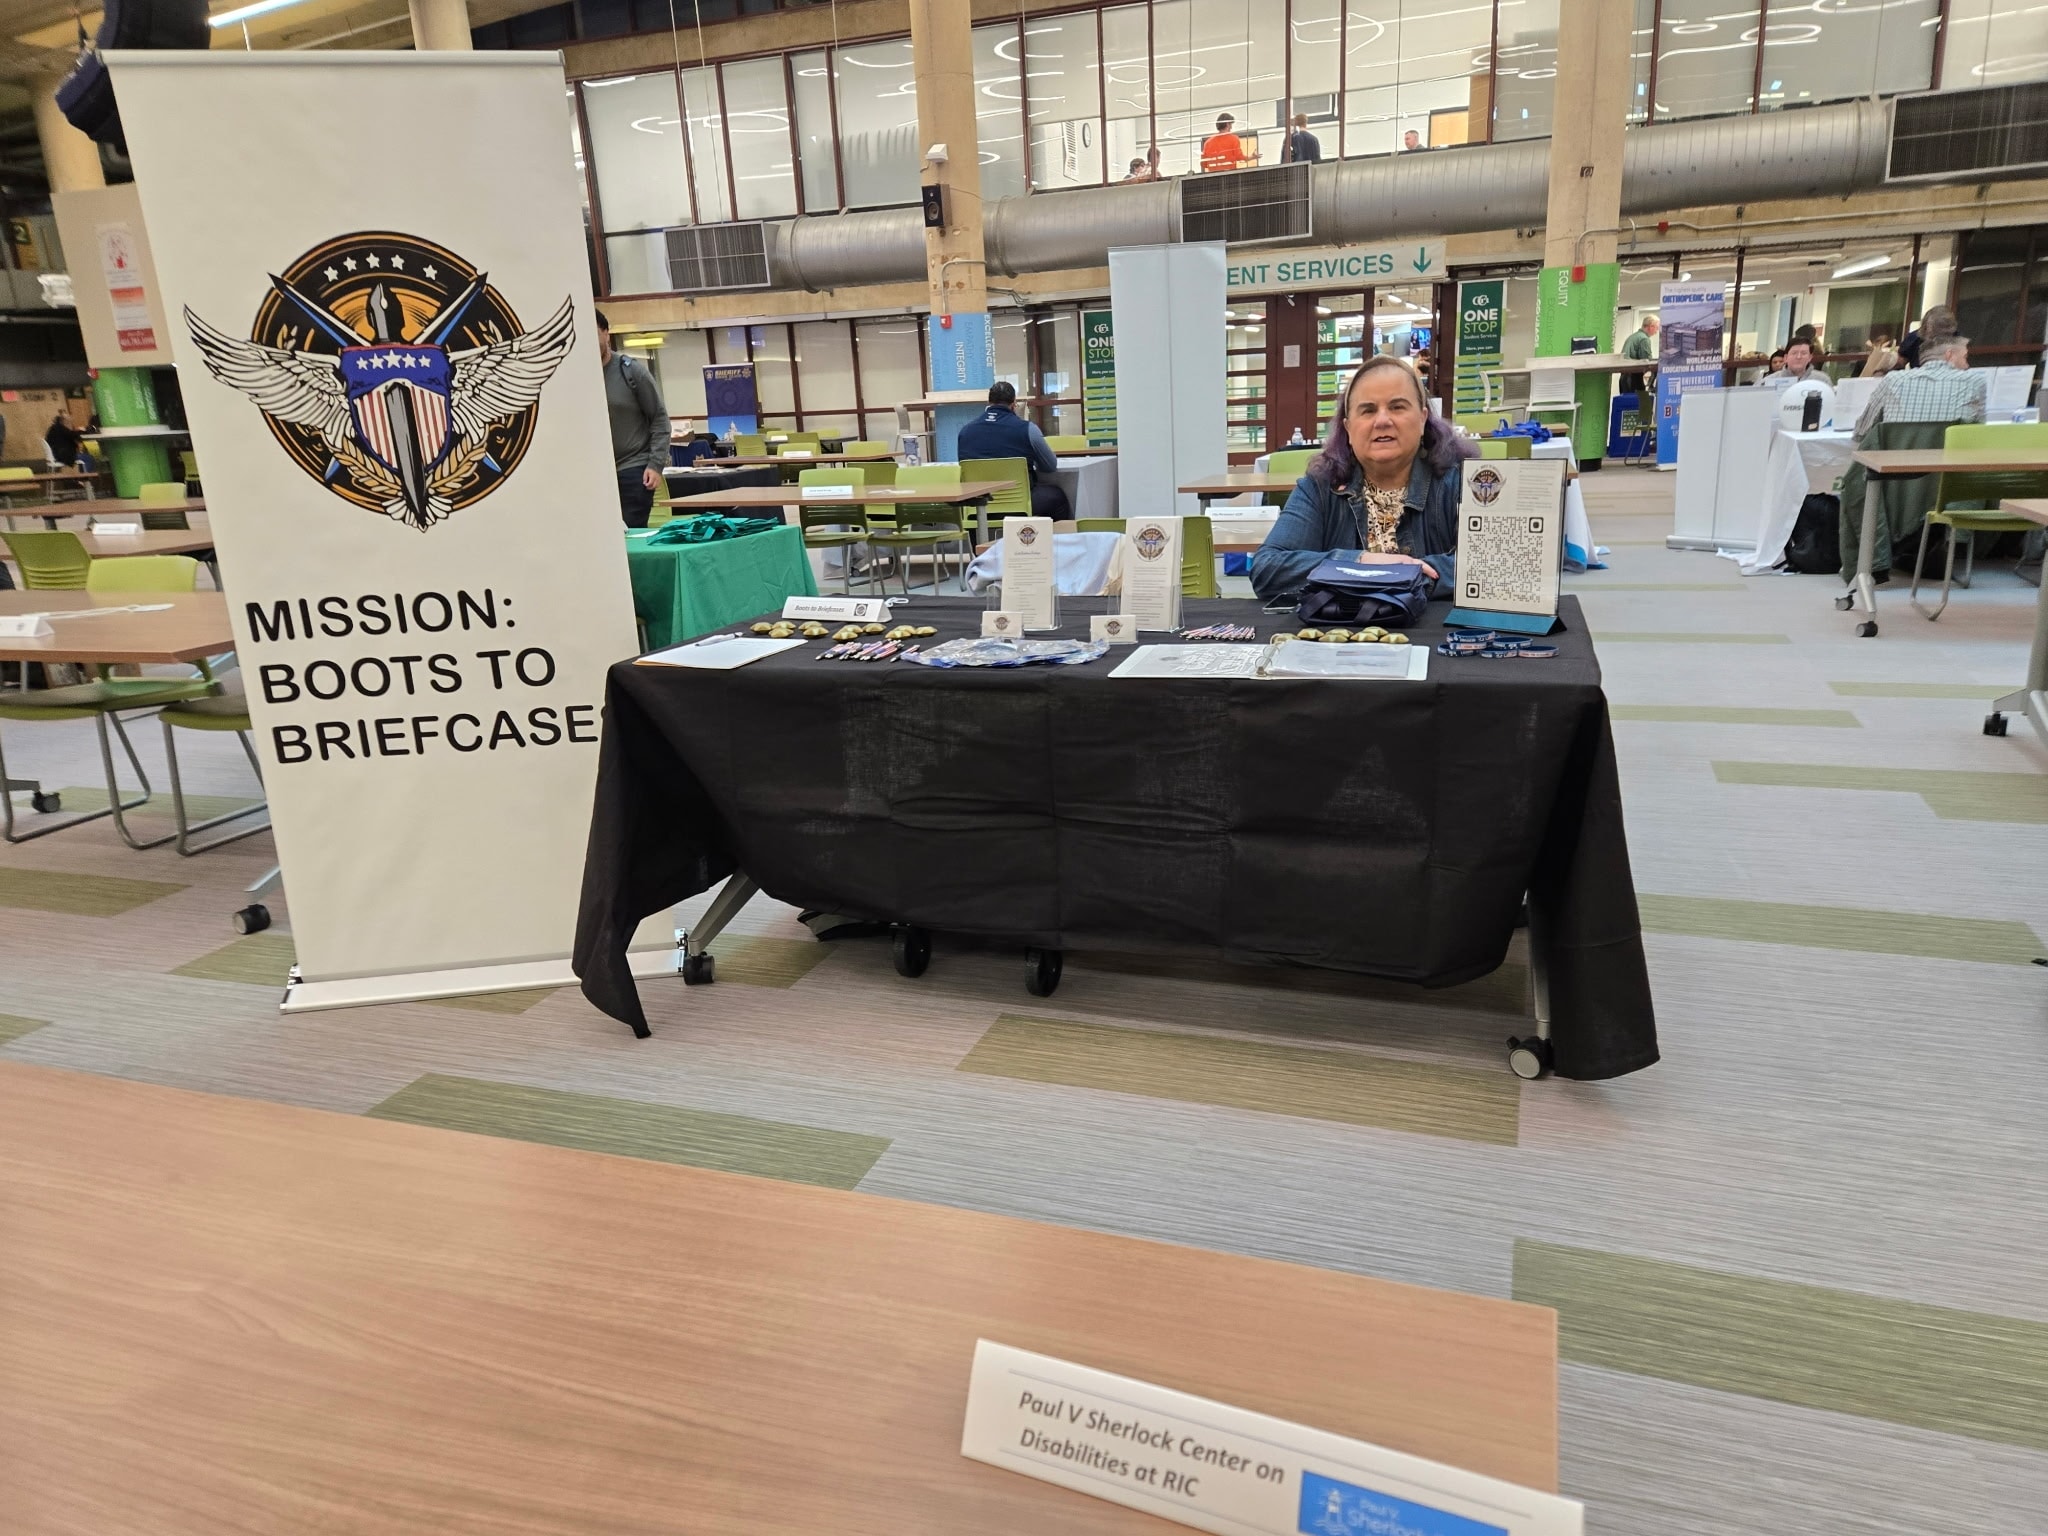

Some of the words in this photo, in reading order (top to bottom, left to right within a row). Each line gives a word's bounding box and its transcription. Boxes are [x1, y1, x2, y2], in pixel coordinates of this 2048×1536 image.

[1227, 265, 1270, 286] ENT
[1277, 254, 1394, 282] SERVICES
[1558, 270, 1569, 306] EQUITY
[1464, 308, 1499, 322] ONE
[1464, 321, 1498, 334] STOP
[983, 314, 993, 368] EXCELLENCE
[1318, 332, 1334, 343] NE
[955, 341, 967, 384] INTEGRITY
[1662, 365, 1689, 374] EDUCATION
[1695, 362, 1723, 371] RESEARCH
[1682, 375, 1715, 385] UNIVERSITY
[245, 587, 516, 643] MISSION:
[259, 652, 463, 704] BOOTS
[476, 647, 556, 689] TO
[272, 704, 604, 764] BRIEFCASE
[1019, 1391, 1063, 1418] Paul
[1069, 1404, 1084, 1424] V
[1086, 1410, 1176, 1452] Sherlock
[1179, 1438, 1253, 1474] Center
[1256, 1463, 1285, 1484] on
[1019, 1428, 1130, 1477] Disabilities
[1135, 1465, 1157, 1485] at
[1162, 1470, 1200, 1497] RIC
